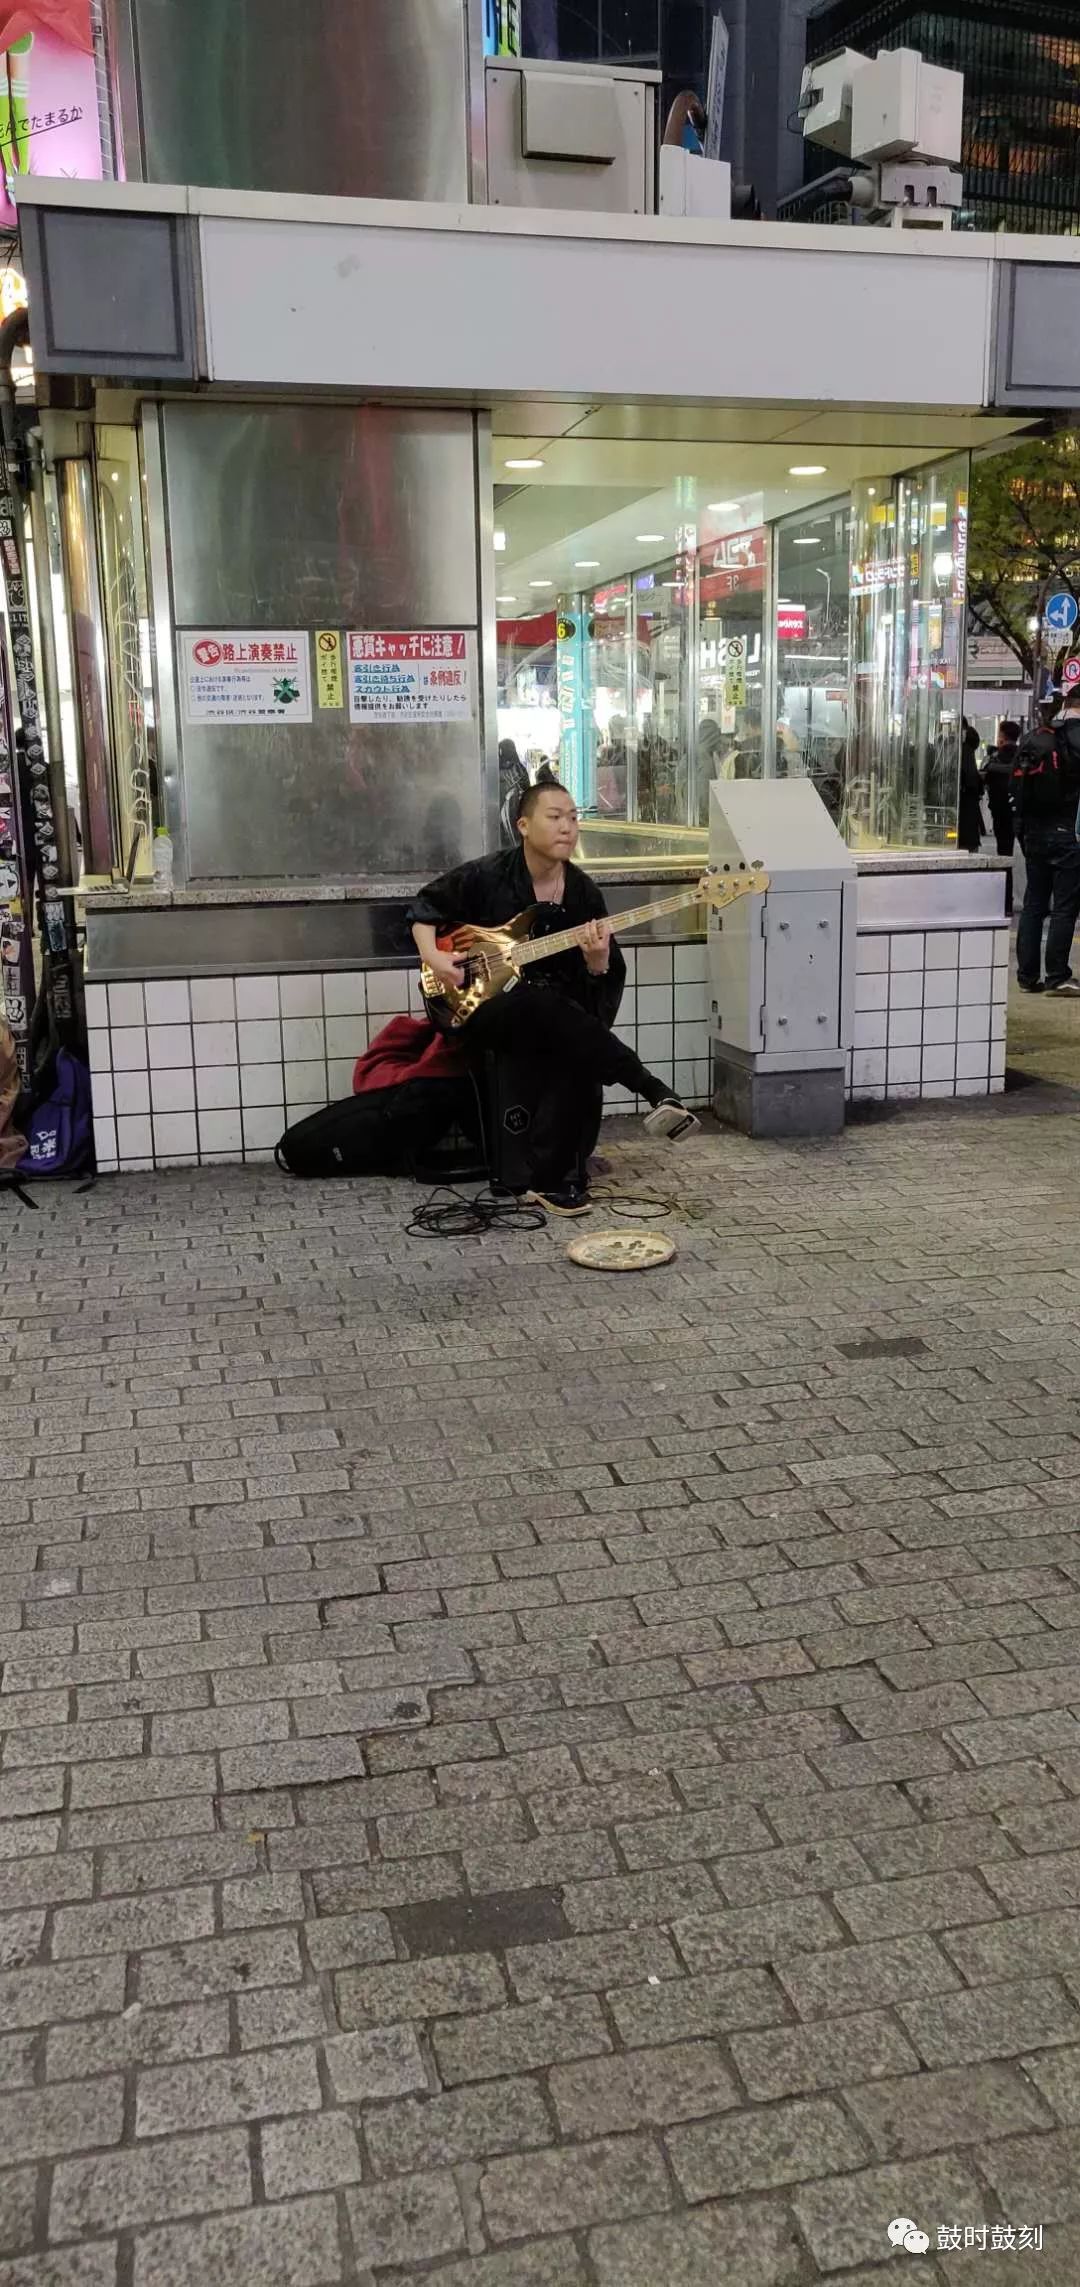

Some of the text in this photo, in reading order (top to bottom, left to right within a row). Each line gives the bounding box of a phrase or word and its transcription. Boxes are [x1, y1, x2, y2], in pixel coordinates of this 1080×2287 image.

[558, 623, 566, 638] 6
[223, 643, 299, 661] 路上演奏禁止
[354, 685, 411, 694] スカウト行為
